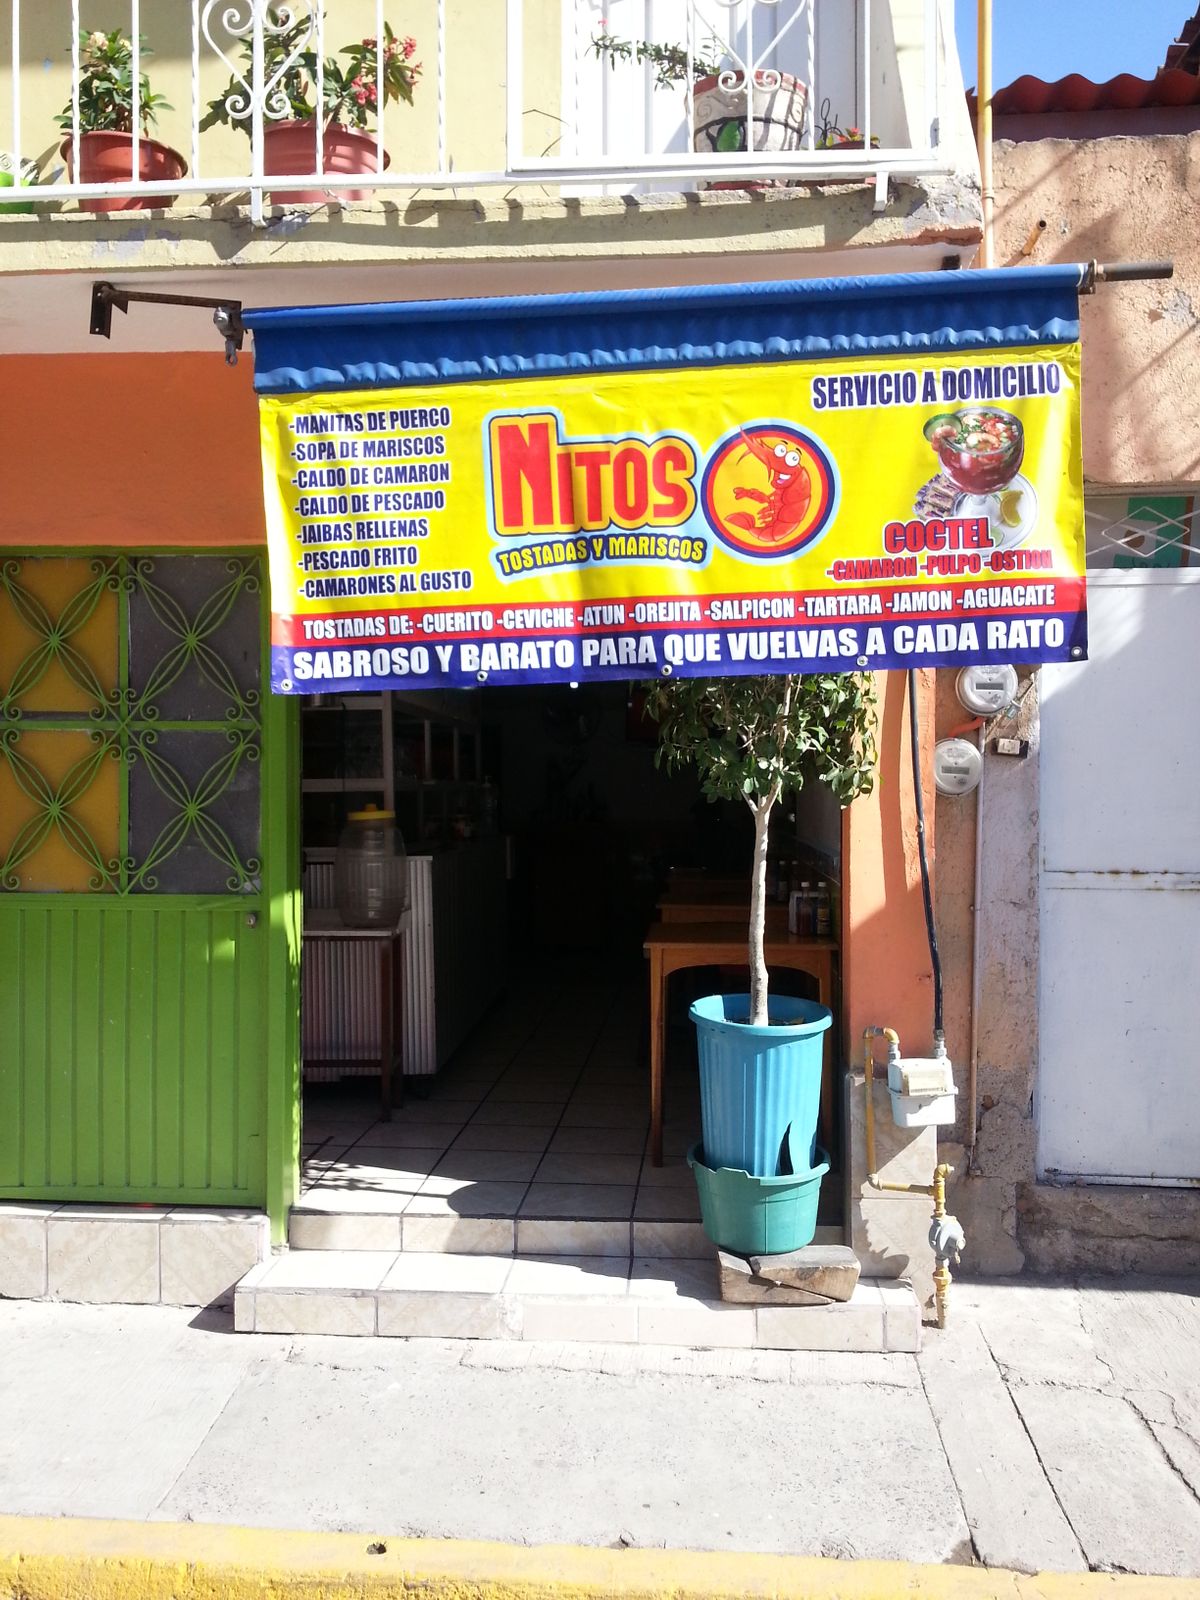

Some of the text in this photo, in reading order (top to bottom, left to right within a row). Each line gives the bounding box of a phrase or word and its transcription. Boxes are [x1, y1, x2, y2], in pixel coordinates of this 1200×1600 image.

[813, 363, 1060, 409] SERVICIO A DOMICILIO
[290, 407, 450, 434] -MANITAS DE PUERCO
[291, 435, 444, 461] -SOPA DE MARISCOS
[292, 463, 450, 488] -CALDO DE CAMARON
[295, 490, 444, 516] -CALDO DE PESCADO
[297, 519, 428, 544] -JAIBAS RELLENAS
[884, 517, 994, 553] COCTEL
[298, 546, 417, 571] -PESCADO FRITO
[499, 536, 704, 573] TOSTADAS Y MARISCOS
[826, 549, 1053, 581] -CAMARON -PULPO -OSTION
[300, 570, 472, 598] -CAMARONES AL GUSTO
[303, 584, 1055, 640] TOSTADAS DE: -CUERITO -CEVICHE -ATUN -OREJITA -SALPICON -TARTARA -JAMON -AGUACATE
[293, 618, 1064, 680] SABROSO Y BARATO PARA QUE VUELVAS A CADA RATO
